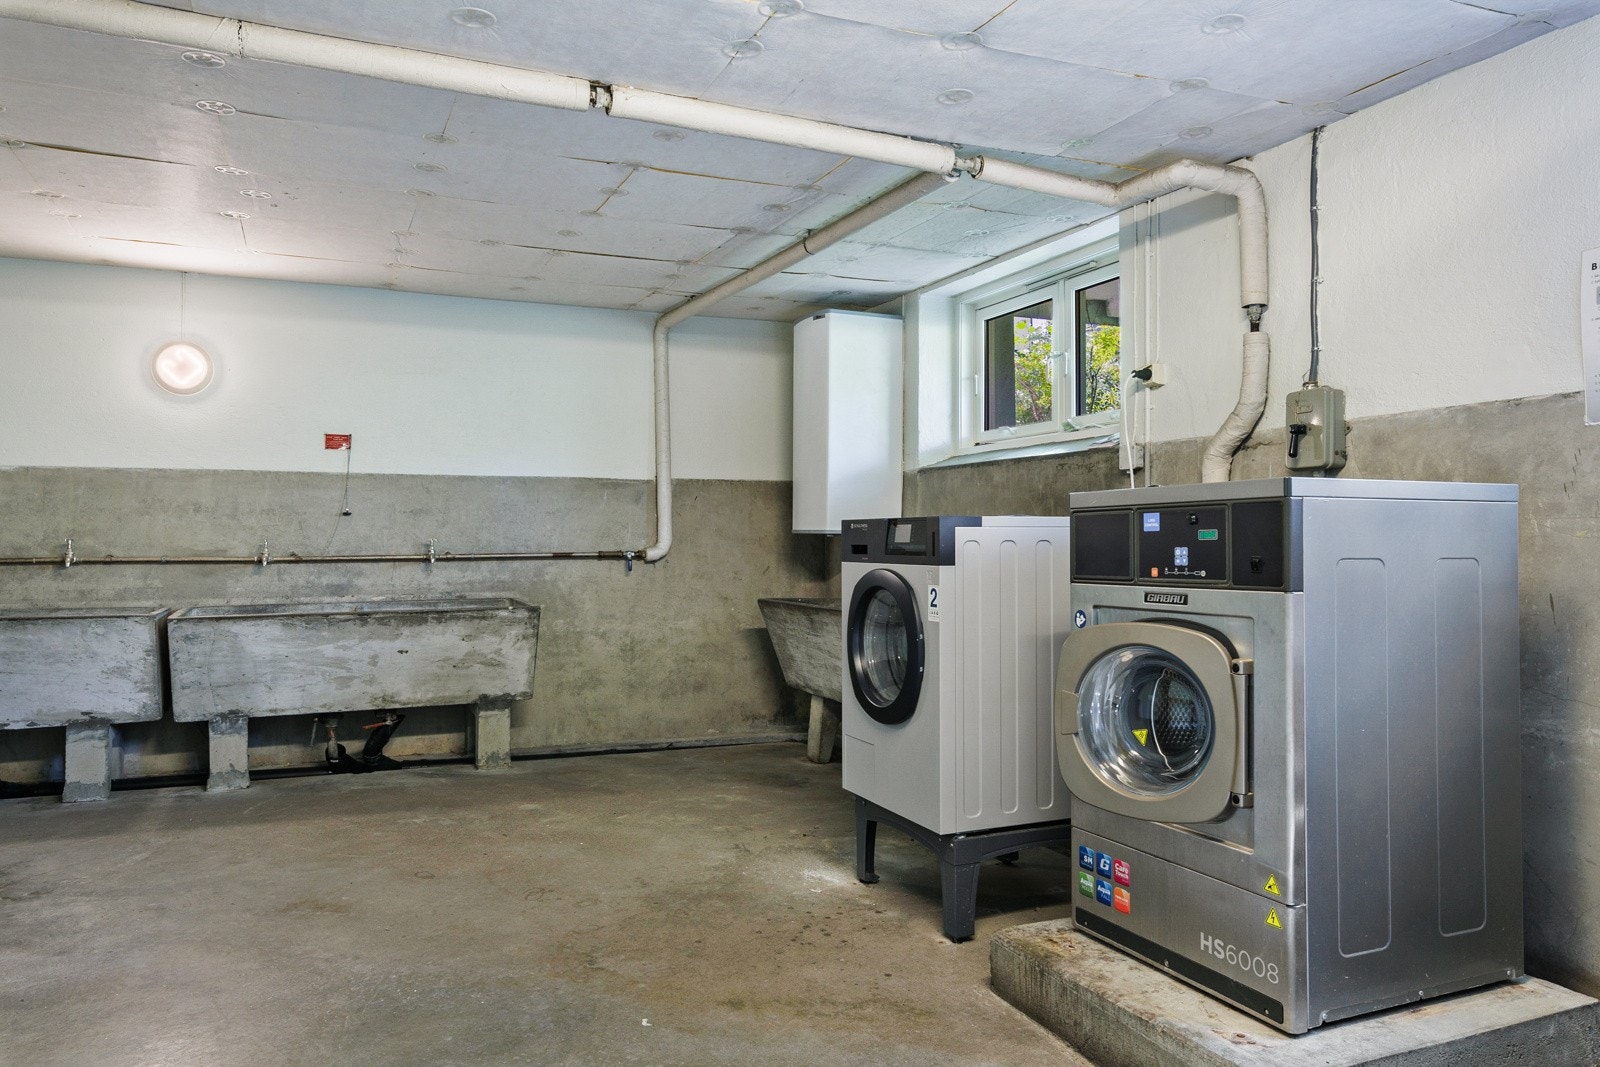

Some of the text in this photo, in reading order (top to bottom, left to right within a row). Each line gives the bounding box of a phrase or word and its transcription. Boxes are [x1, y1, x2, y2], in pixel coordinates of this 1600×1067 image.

[930, 587, 938, 608] 2
[1147, 593, 1185, 604] GIRBAU
[1100, 858, 1110, 871] G
[1114, 862, 1129, 874] Care
[1097, 884, 1111, 896] Aqua
[1200, 931, 1279, 984] HS6008
